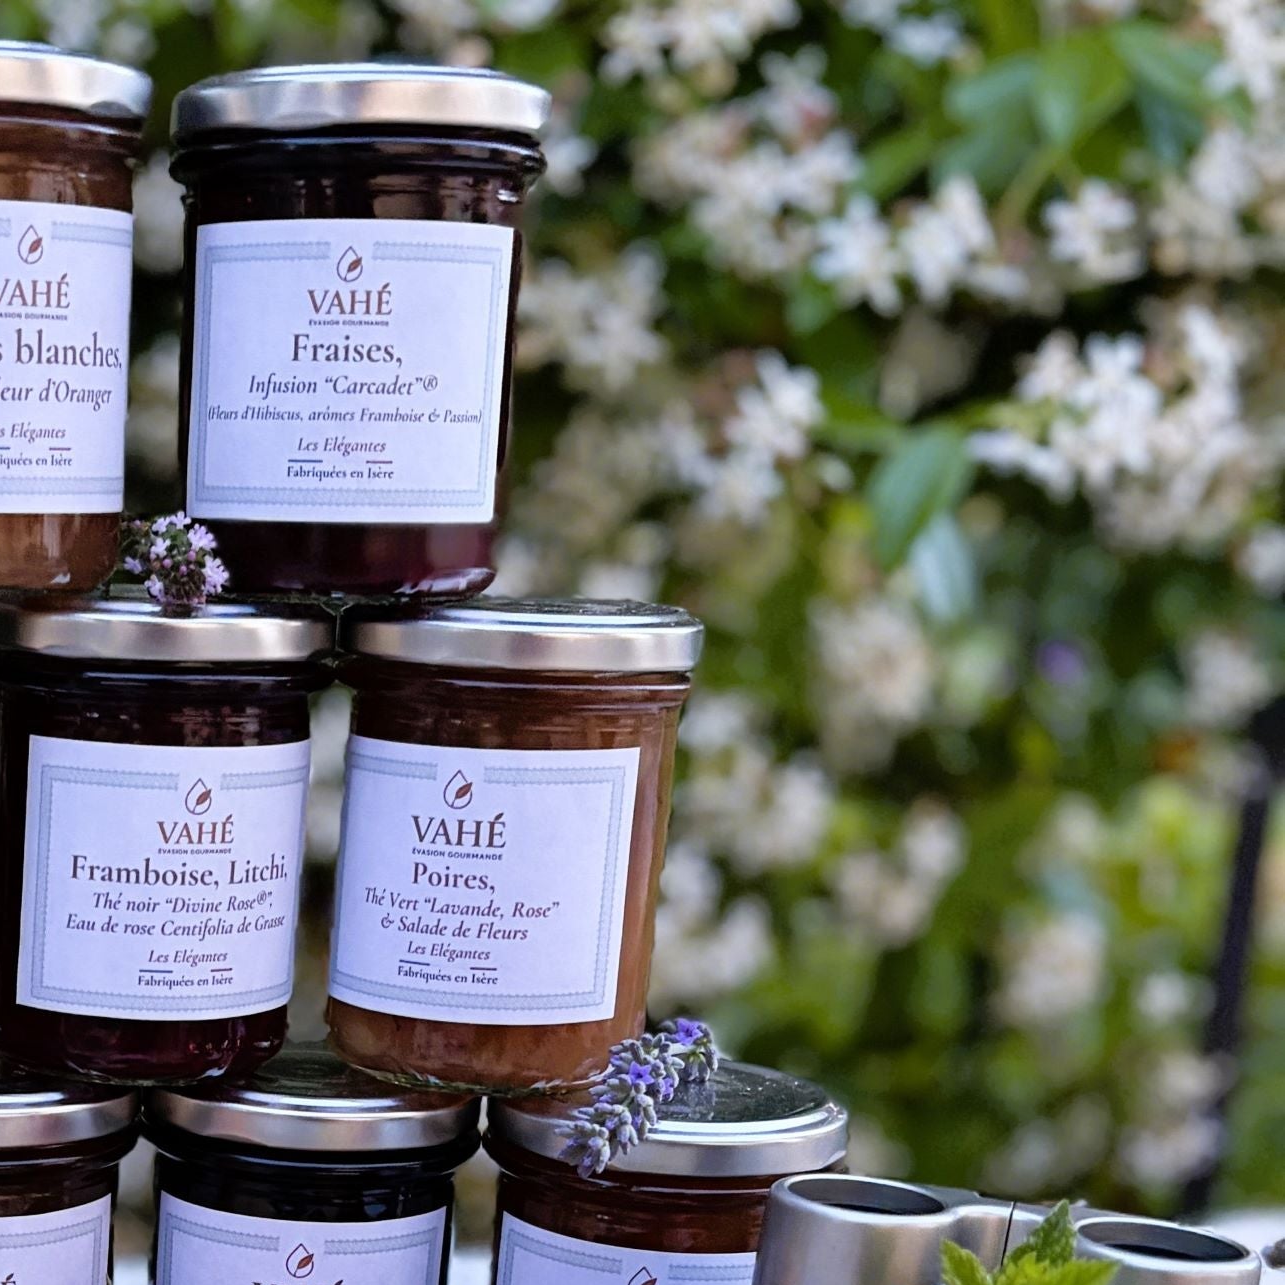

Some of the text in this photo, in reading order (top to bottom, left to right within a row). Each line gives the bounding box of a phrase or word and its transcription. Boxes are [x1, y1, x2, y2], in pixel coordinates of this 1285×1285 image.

[307, 282, 393, 316] VAHÉ
[15, 329, 122, 369] blanches,
[291, 333, 403, 368] Fraises,
[249, 373, 317, 399] Infusion
[308, 406, 354, 422] arômes
[360, 407, 424, 423] Framboise
[428, 409, 440, 423] &
[443, 409, 482, 424] Passion)
[10, 422, 66, 443] Elégantes
[298, 436, 386, 456] Les Elégantes
[36, 456, 47, 466] en
[51, 454, 72, 467] Isère
[287, 466, 394, 481] Fabriquées en Isère
[157, 814, 234, 845] VAHÉ
[411, 812, 506, 849] VAHÉ
[71, 854, 287, 889] Framboise, Litchi,
[412, 862, 495, 894] Poires,
[93, 892, 122, 909] Thé
[126, 897, 160, 913] noir
[166, 896, 221, 913] “Divine
[365, 887, 559, 919] Thé Vert “Lavande, Rose”
[66, 913, 285, 941] Eau de rose Centifolia de Grasse
[381, 913, 528, 940] & Salade de Fleurs
[148, 949, 227, 967] Les Elégantes
[407, 941, 490, 962] Les Elégantes
[138, 973, 233, 990] Fabriquées en Isère
[397, 966, 498, 985] Fabriquées en Isère
